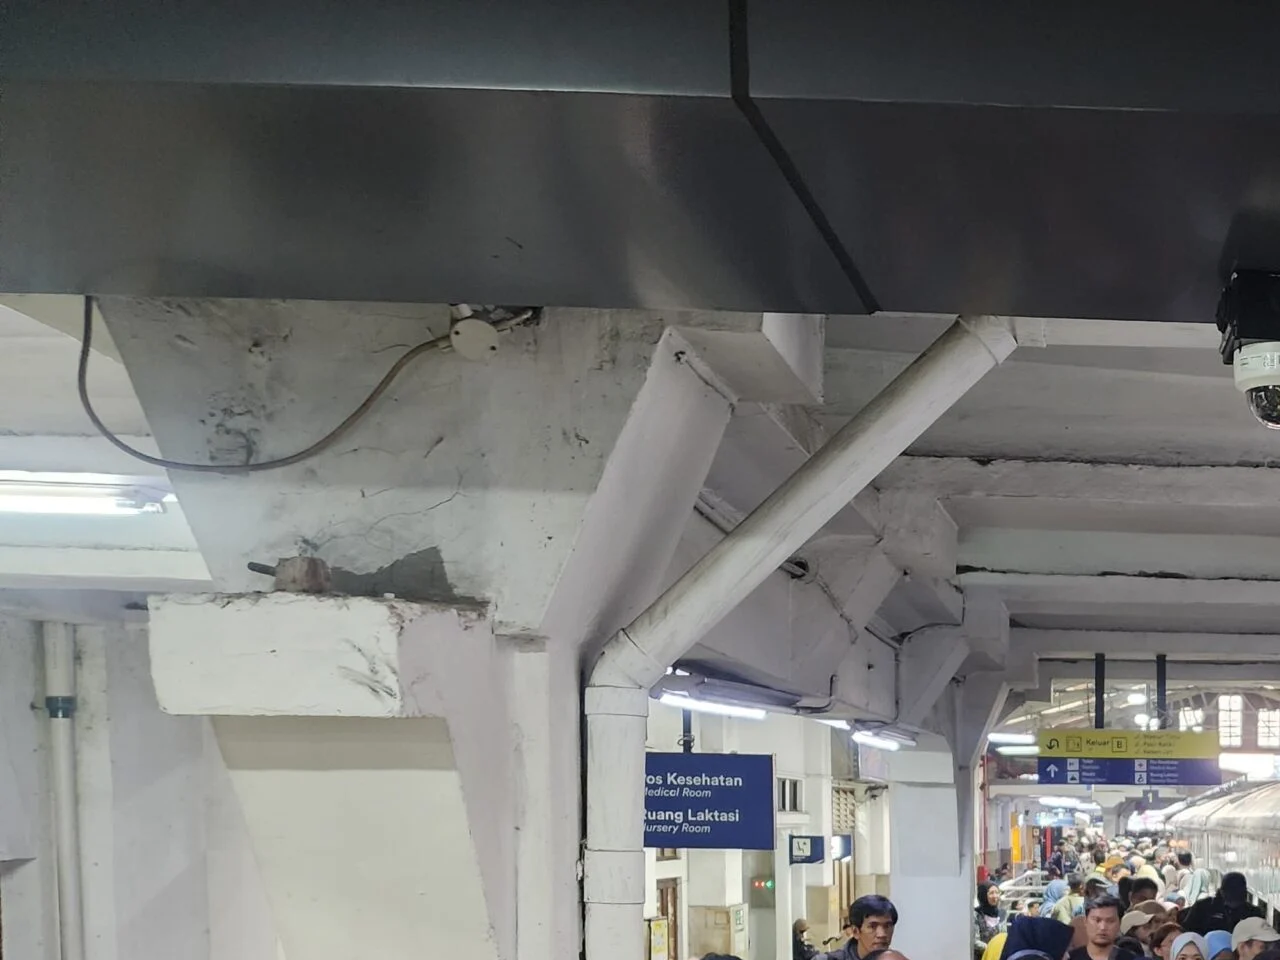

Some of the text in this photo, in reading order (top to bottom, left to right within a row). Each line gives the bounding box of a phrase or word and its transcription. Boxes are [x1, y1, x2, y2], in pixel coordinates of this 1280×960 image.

[1086, 737, 1110, 747] Keluar
[645, 772, 743, 787] os Kesehatan
[682, 787, 712, 798] Room
[687, 808, 739, 822] Laktasi
[682, 823, 711, 834] Room
